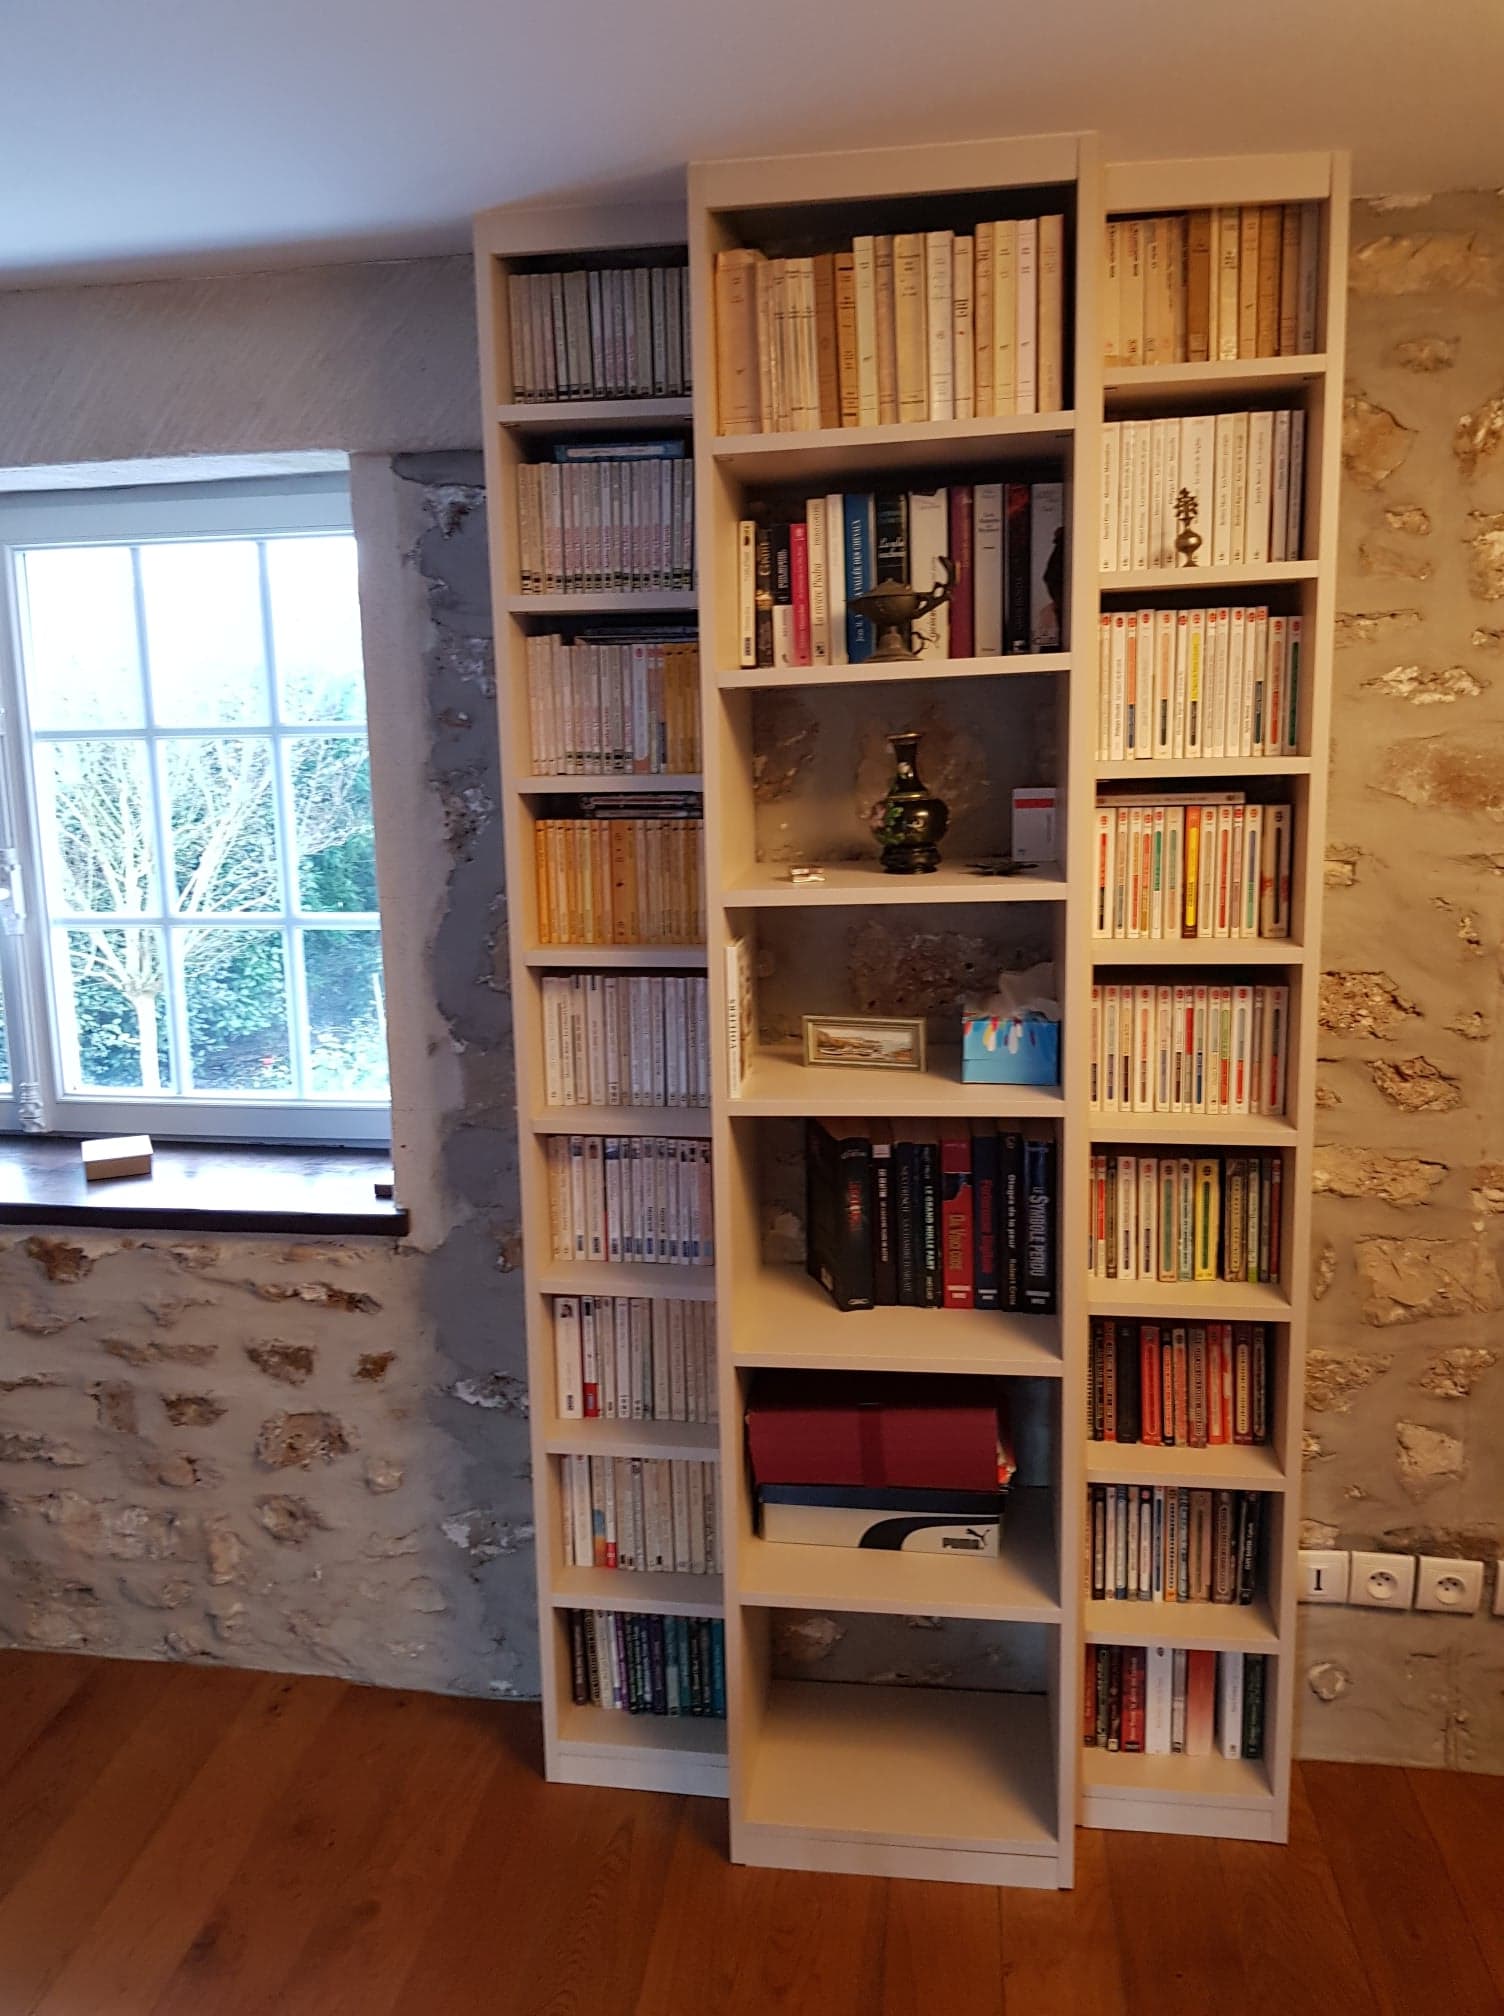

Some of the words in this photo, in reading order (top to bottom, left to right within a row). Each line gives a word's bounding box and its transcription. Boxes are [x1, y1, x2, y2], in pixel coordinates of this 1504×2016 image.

[924, 1185, 934, 1195] LE
[924, 1195, 934, 1224] GRAND
[924, 1224, 935, 1249] NULLE
[925, 1249, 935, 1271] PART
